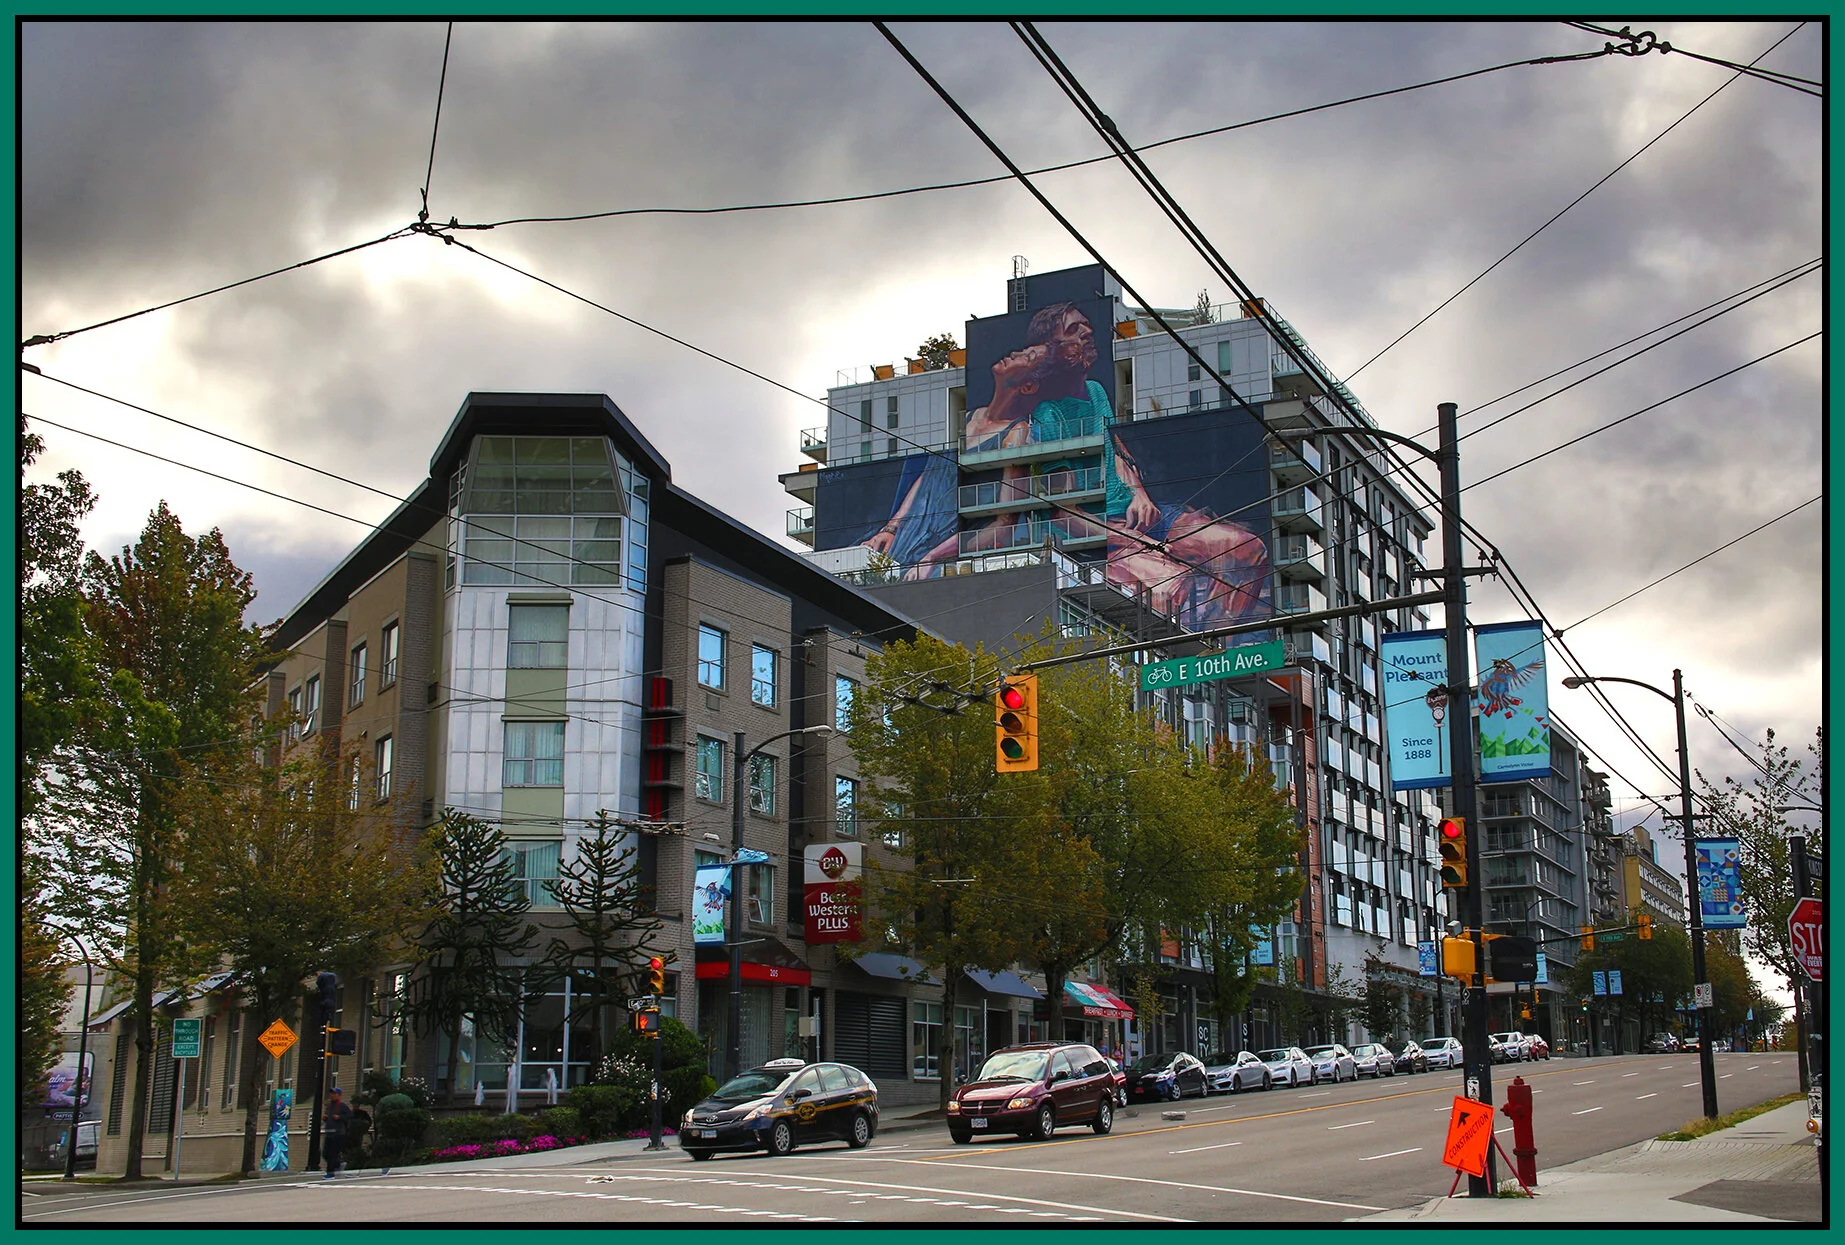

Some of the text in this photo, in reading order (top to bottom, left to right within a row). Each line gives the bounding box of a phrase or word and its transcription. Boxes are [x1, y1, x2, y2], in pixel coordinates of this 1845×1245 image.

[1179, 653, 1269, 680] E 10th Ave.
[1392, 652, 1442, 667] Mount
[1402, 737, 1433, 747] Since
[1404, 749, 1432, 760] 1888
[817, 917, 849, 930] PLUS
[1448, 1111, 1489, 1160] CONSTRUCTION
